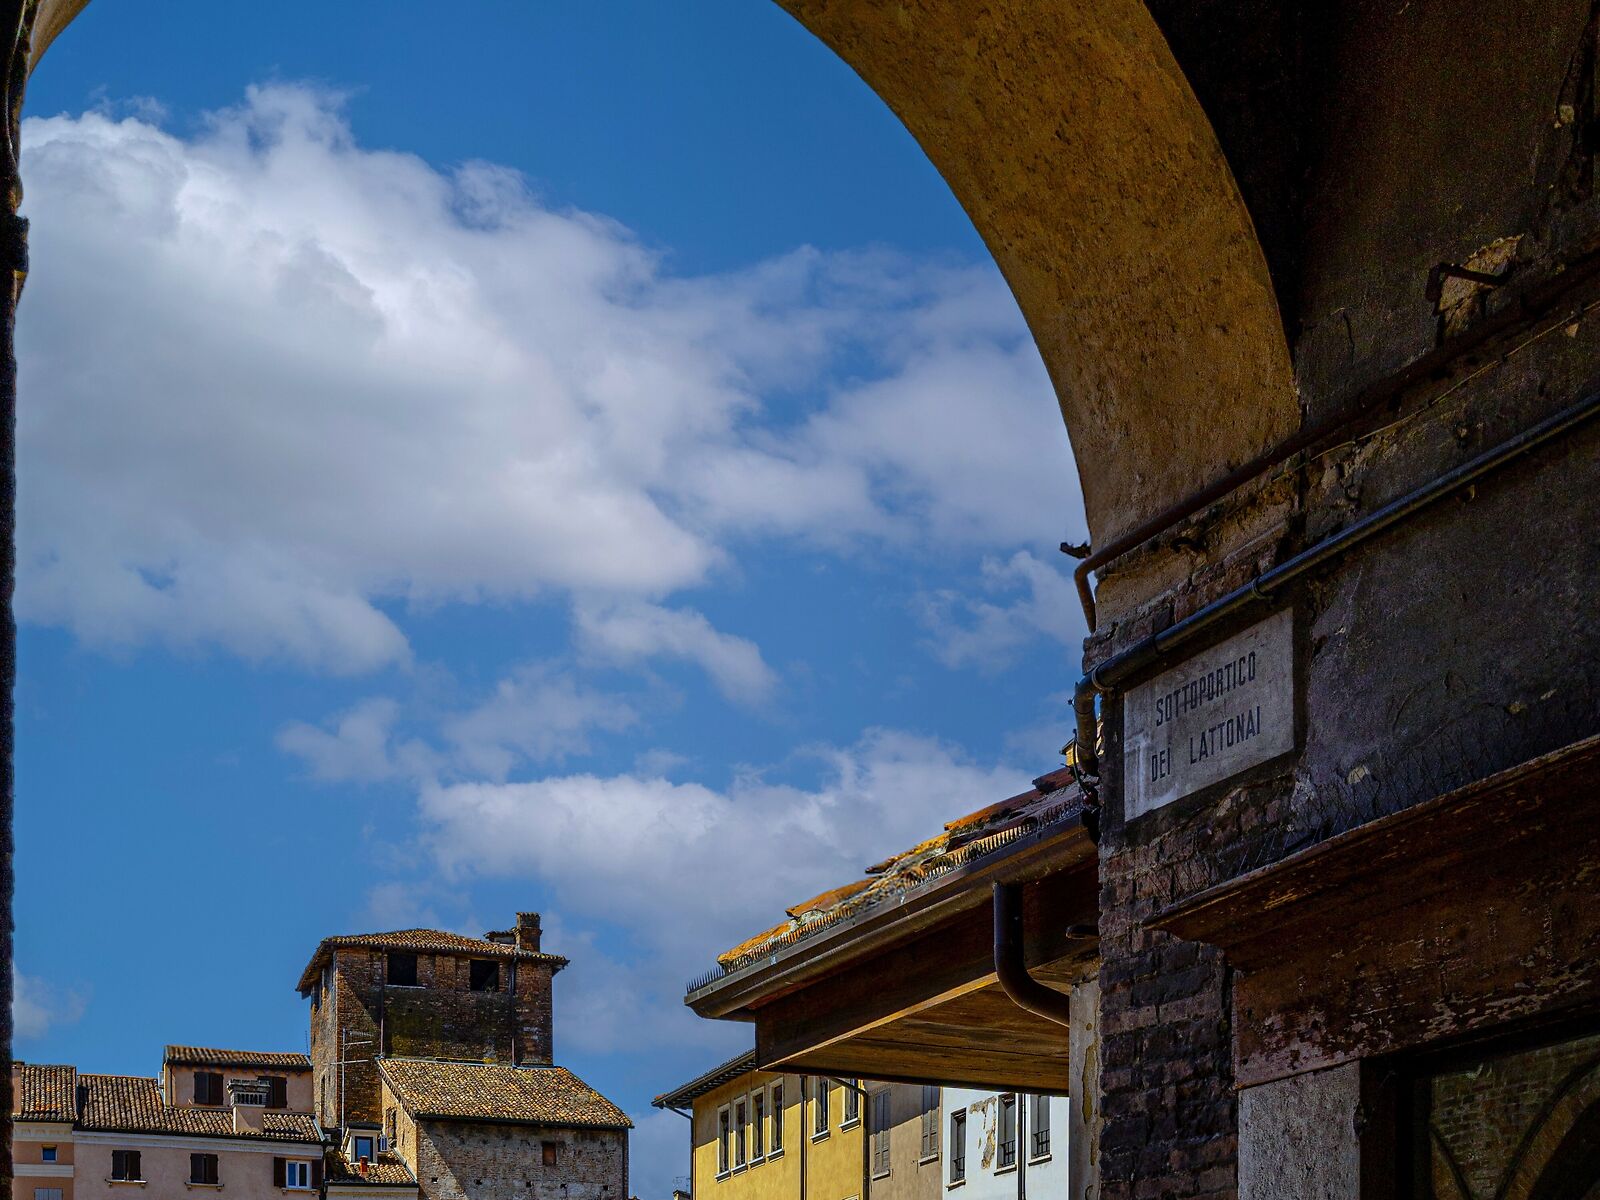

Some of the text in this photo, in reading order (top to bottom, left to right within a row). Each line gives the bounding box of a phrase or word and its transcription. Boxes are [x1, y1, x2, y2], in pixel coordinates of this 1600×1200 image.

[1156, 651, 1256, 727] SOTTOPORTICO
[1151, 705, 1261, 783] DEI LATTONAI
